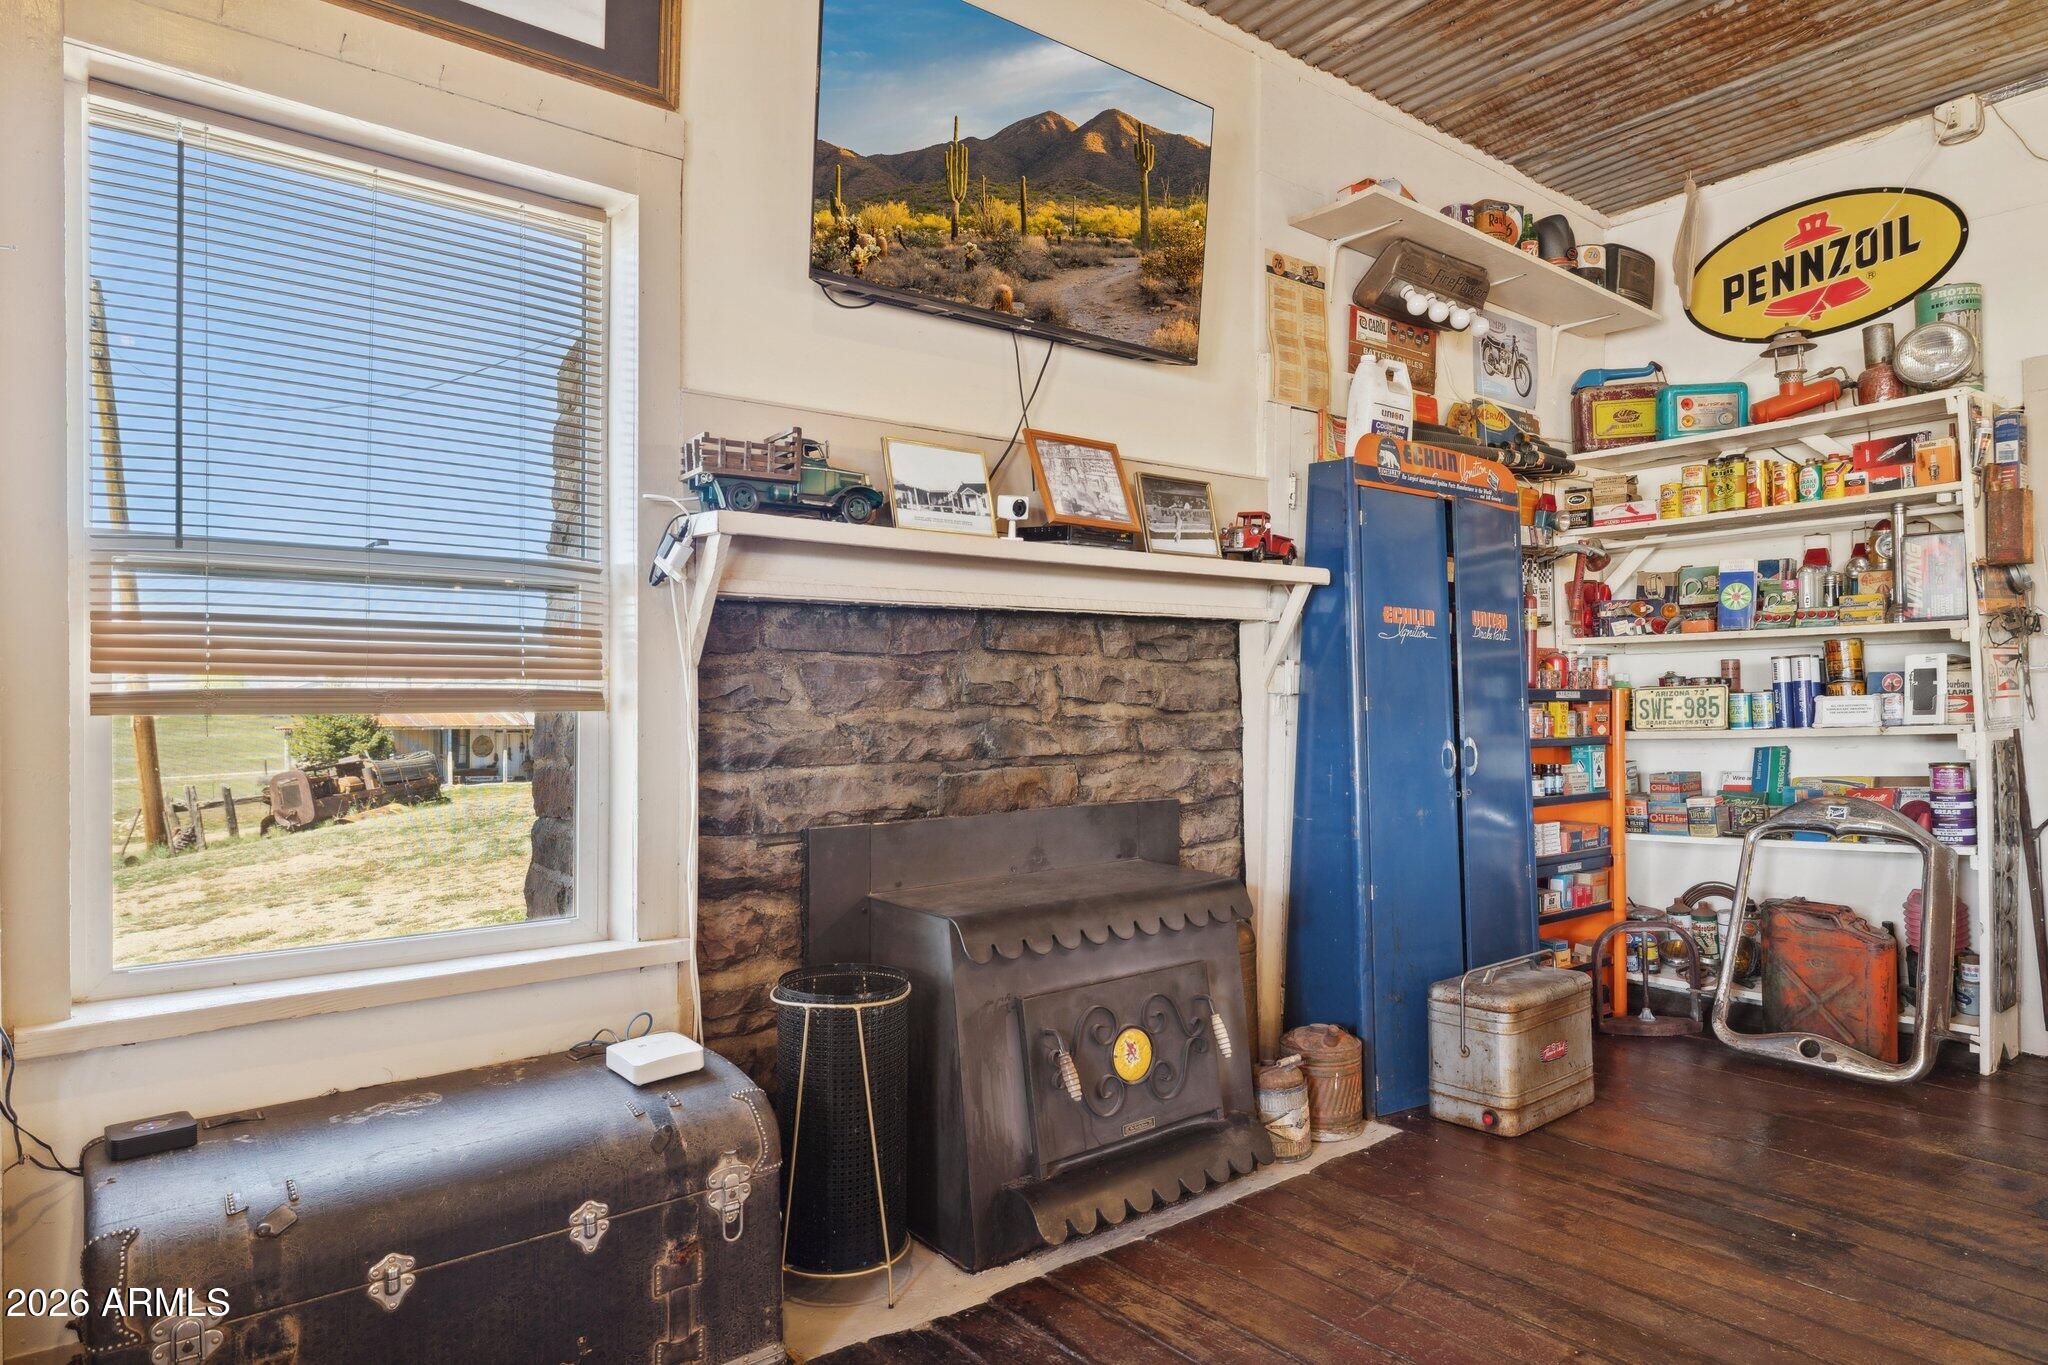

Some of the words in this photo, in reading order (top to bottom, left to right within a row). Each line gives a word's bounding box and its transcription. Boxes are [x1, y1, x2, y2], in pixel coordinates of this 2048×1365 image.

[1273, 257, 1283, 270] 76
[1722, 214, 1921, 314] PENNZOIL
[1363, 347, 1394, 361] BATTERY
[1403, 445, 1458, 473] ECHLIN
[1382, 605, 1435, 627] ECHLIN
[1883, 677, 1901, 687] AC
[1655, 690, 1690, 698] ARIZONA
[1694, 689, 1706, 697] 73
[1639, 695, 1720, 720] SWE-985
[1777, 749, 1787, 794] CRESCENT
[1650, 783, 1661, 792] Oil
[1662, 783, 1681, 792] Filter
[1650, 814, 1665, 822] Oil
[1665, 813, 1687, 823] Filter
